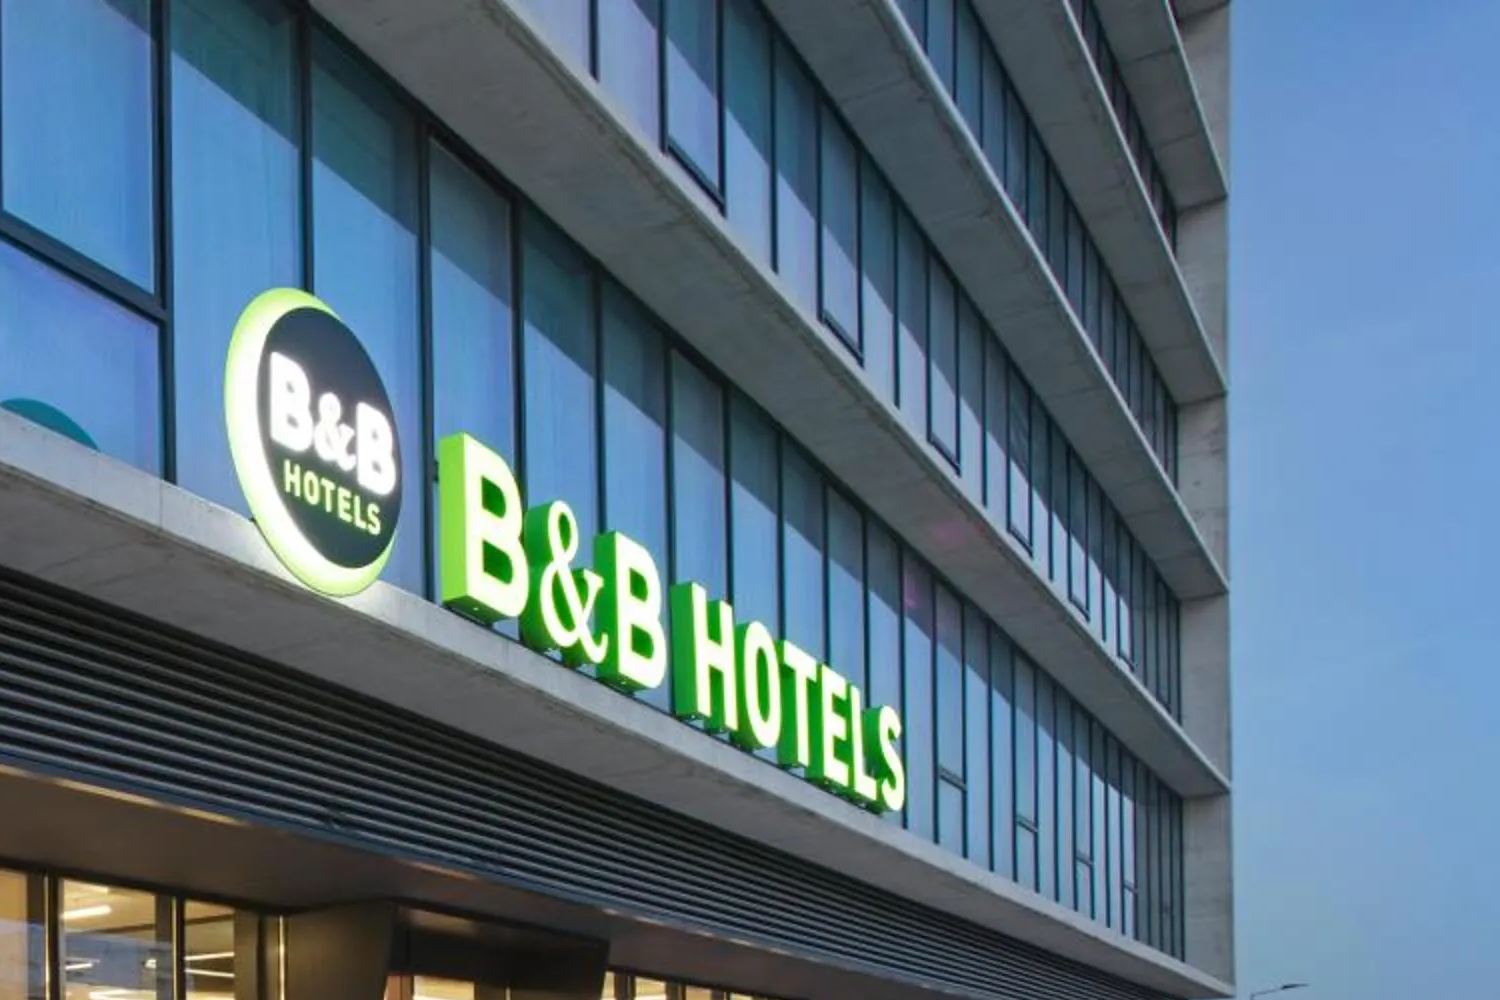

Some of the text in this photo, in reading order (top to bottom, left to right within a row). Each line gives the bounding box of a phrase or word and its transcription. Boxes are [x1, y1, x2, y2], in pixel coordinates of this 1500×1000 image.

[269, 350, 397, 497] B&B
[283, 458, 382, 536] HOTELS
[439, 432, 906, 813] B&B HOTELS
